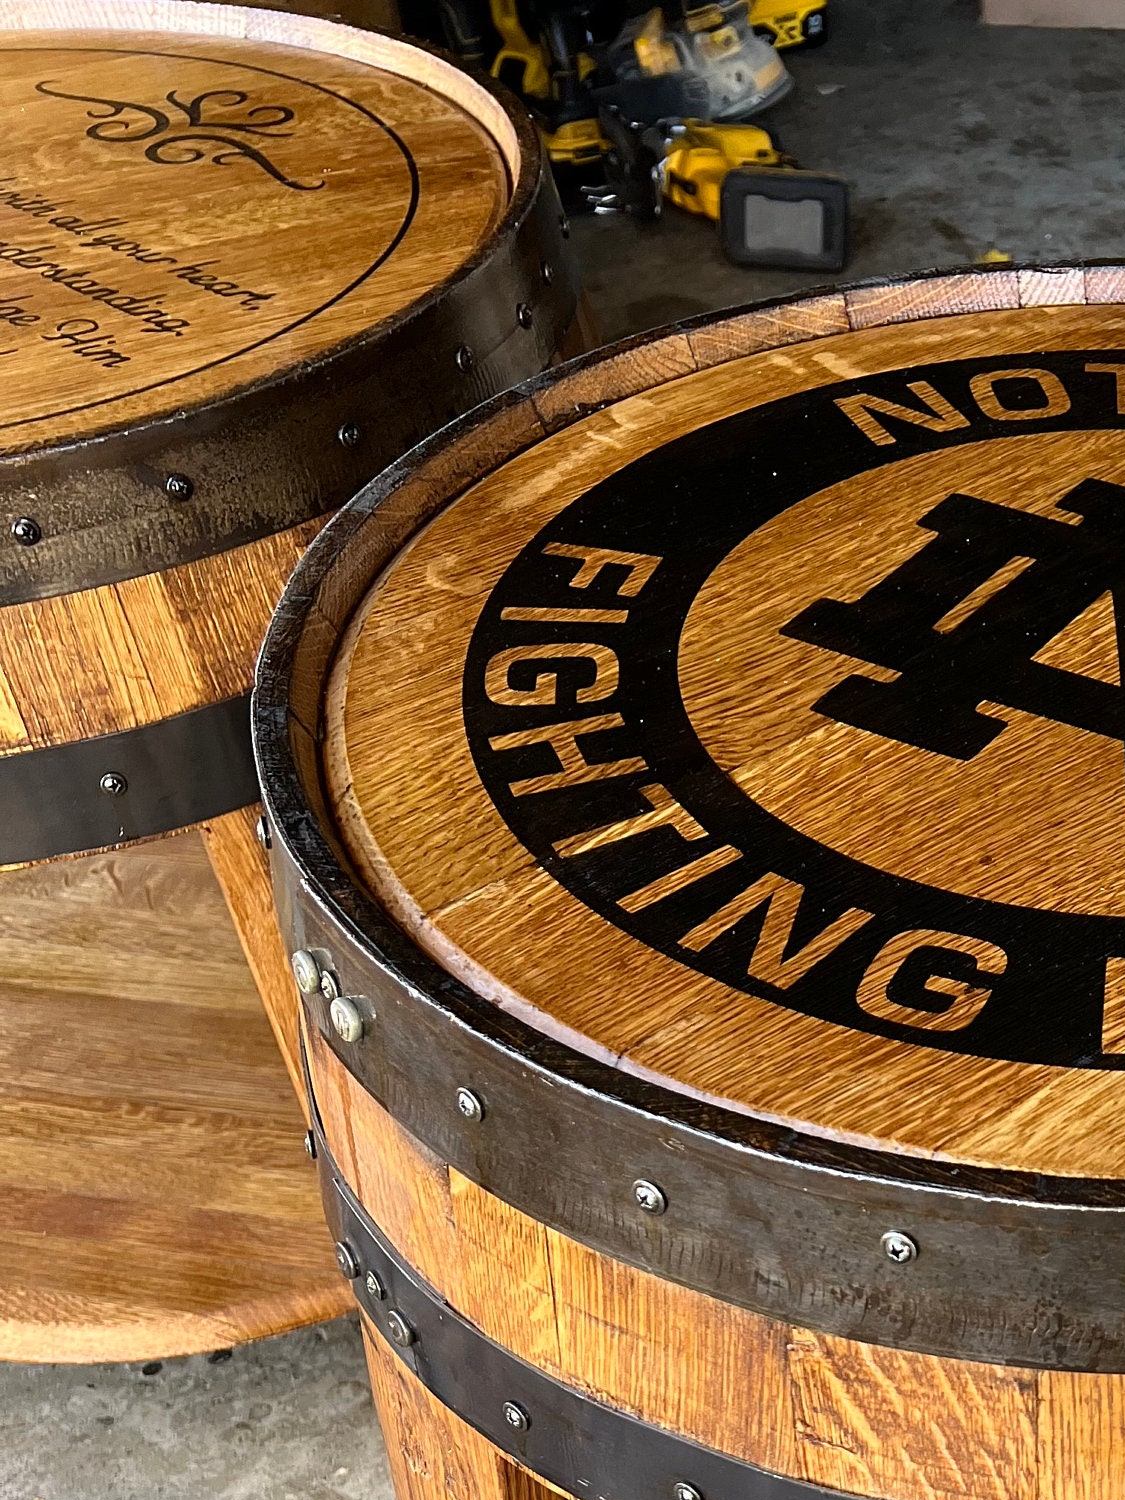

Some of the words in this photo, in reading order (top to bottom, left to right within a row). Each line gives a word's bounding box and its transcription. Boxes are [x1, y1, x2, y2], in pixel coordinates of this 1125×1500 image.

[48, 215, 129, 235] all
[79, 233, 178, 263] your
[168, 259, 277, 311] heart,
[41, 318, 131, 368] Him
[484, 541, 1009, 1032] FIGHTING
